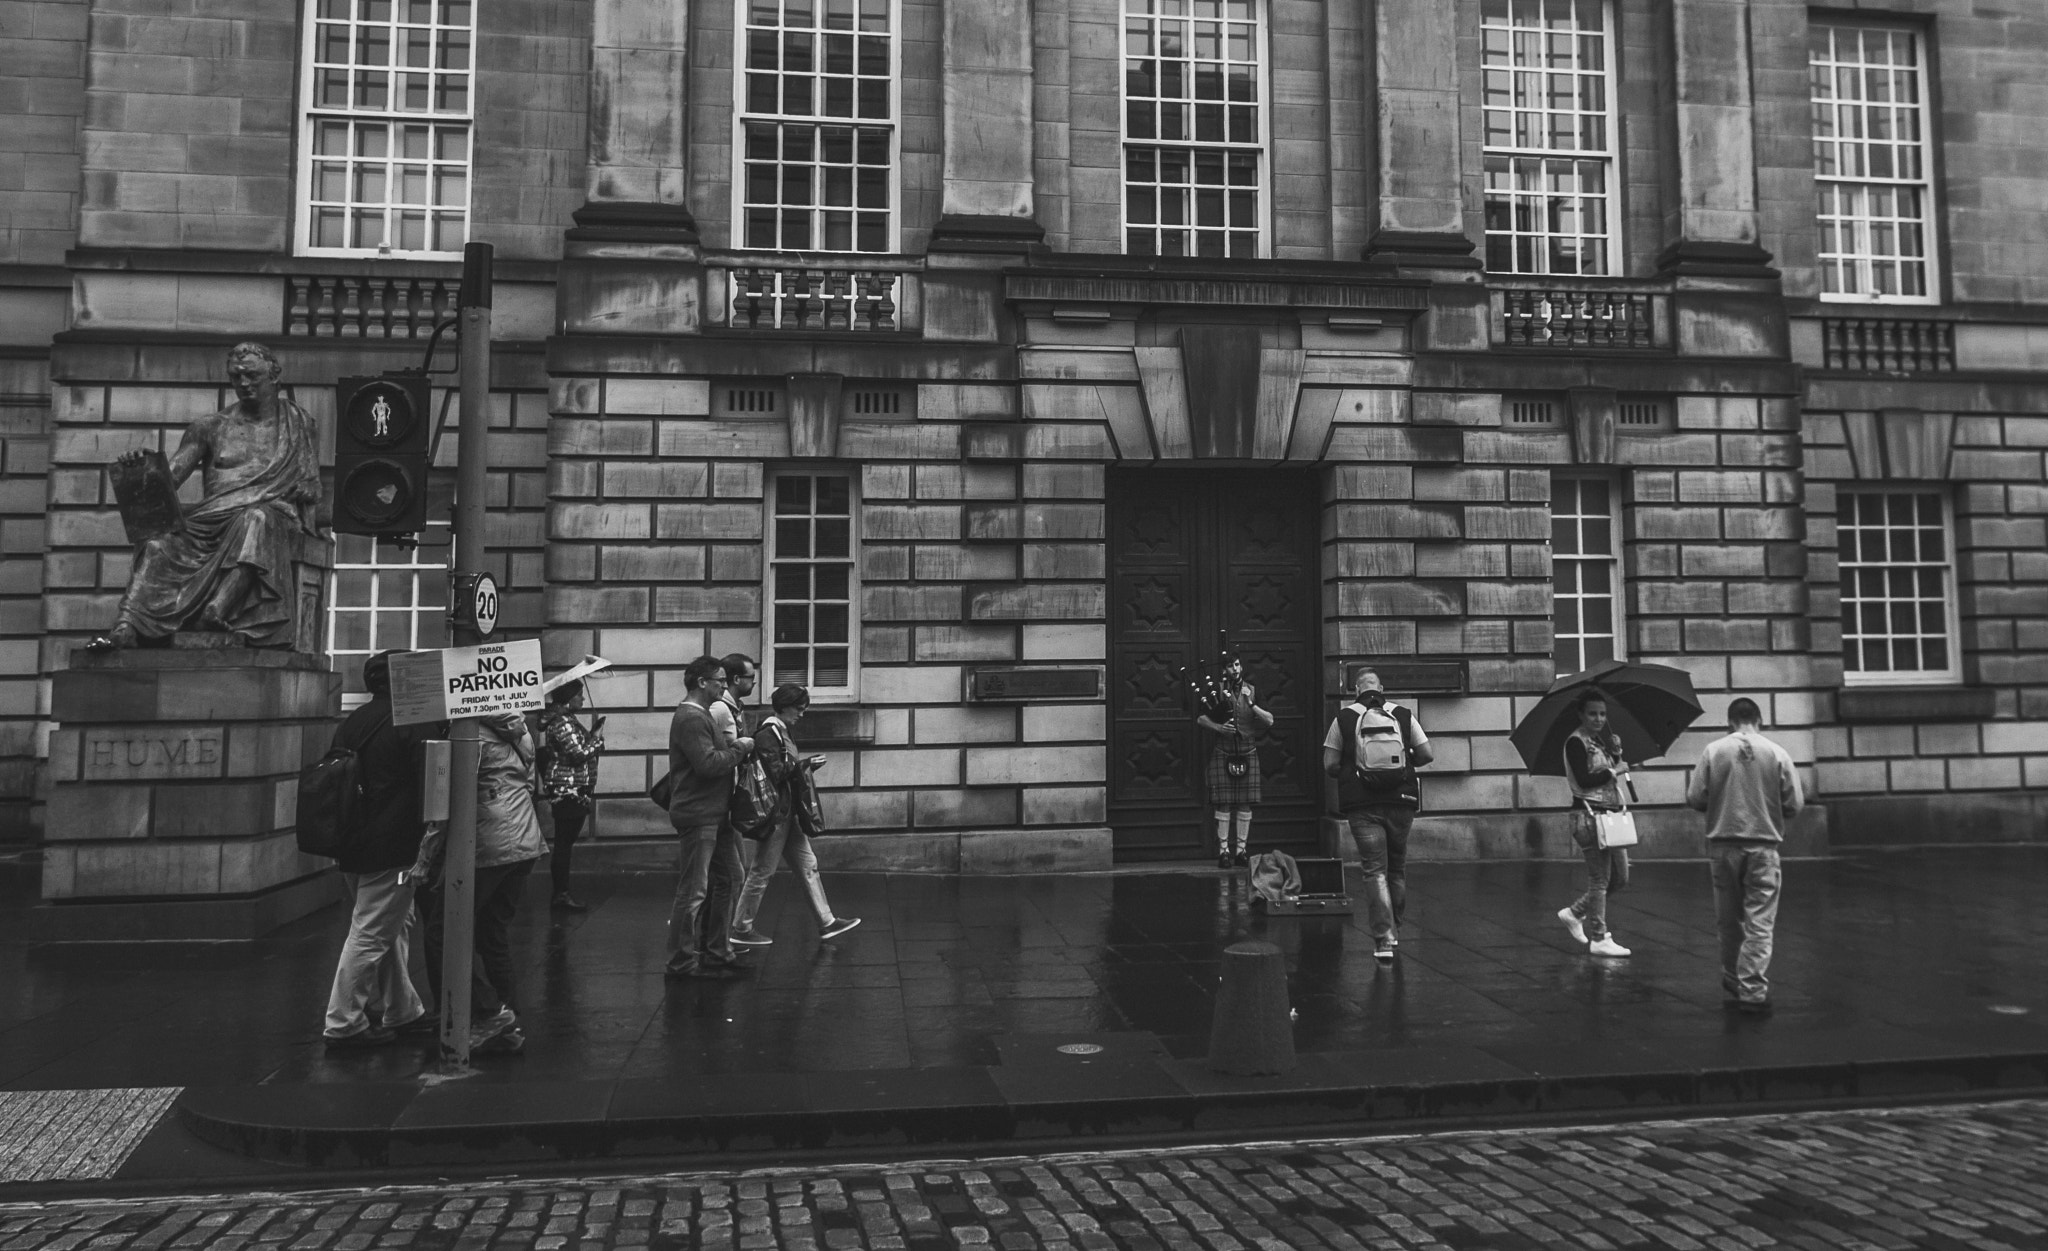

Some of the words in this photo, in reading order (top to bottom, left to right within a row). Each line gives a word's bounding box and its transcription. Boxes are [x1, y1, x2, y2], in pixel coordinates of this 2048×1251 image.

[478, 591, 496, 620] 20
[479, 646, 505, 655] PARADE
[477, 656, 508, 673] NO
[449, 670, 538, 694] PARKING
[462, 695, 490, 705] FRIDAY
[509, 691, 528, 700] JULY
[450, 706, 471, 715] FROM
[474, 704, 499, 713] 7.30pm
[514, 700, 541, 708] 8.30pm
[89, 738, 217, 767] HUME
